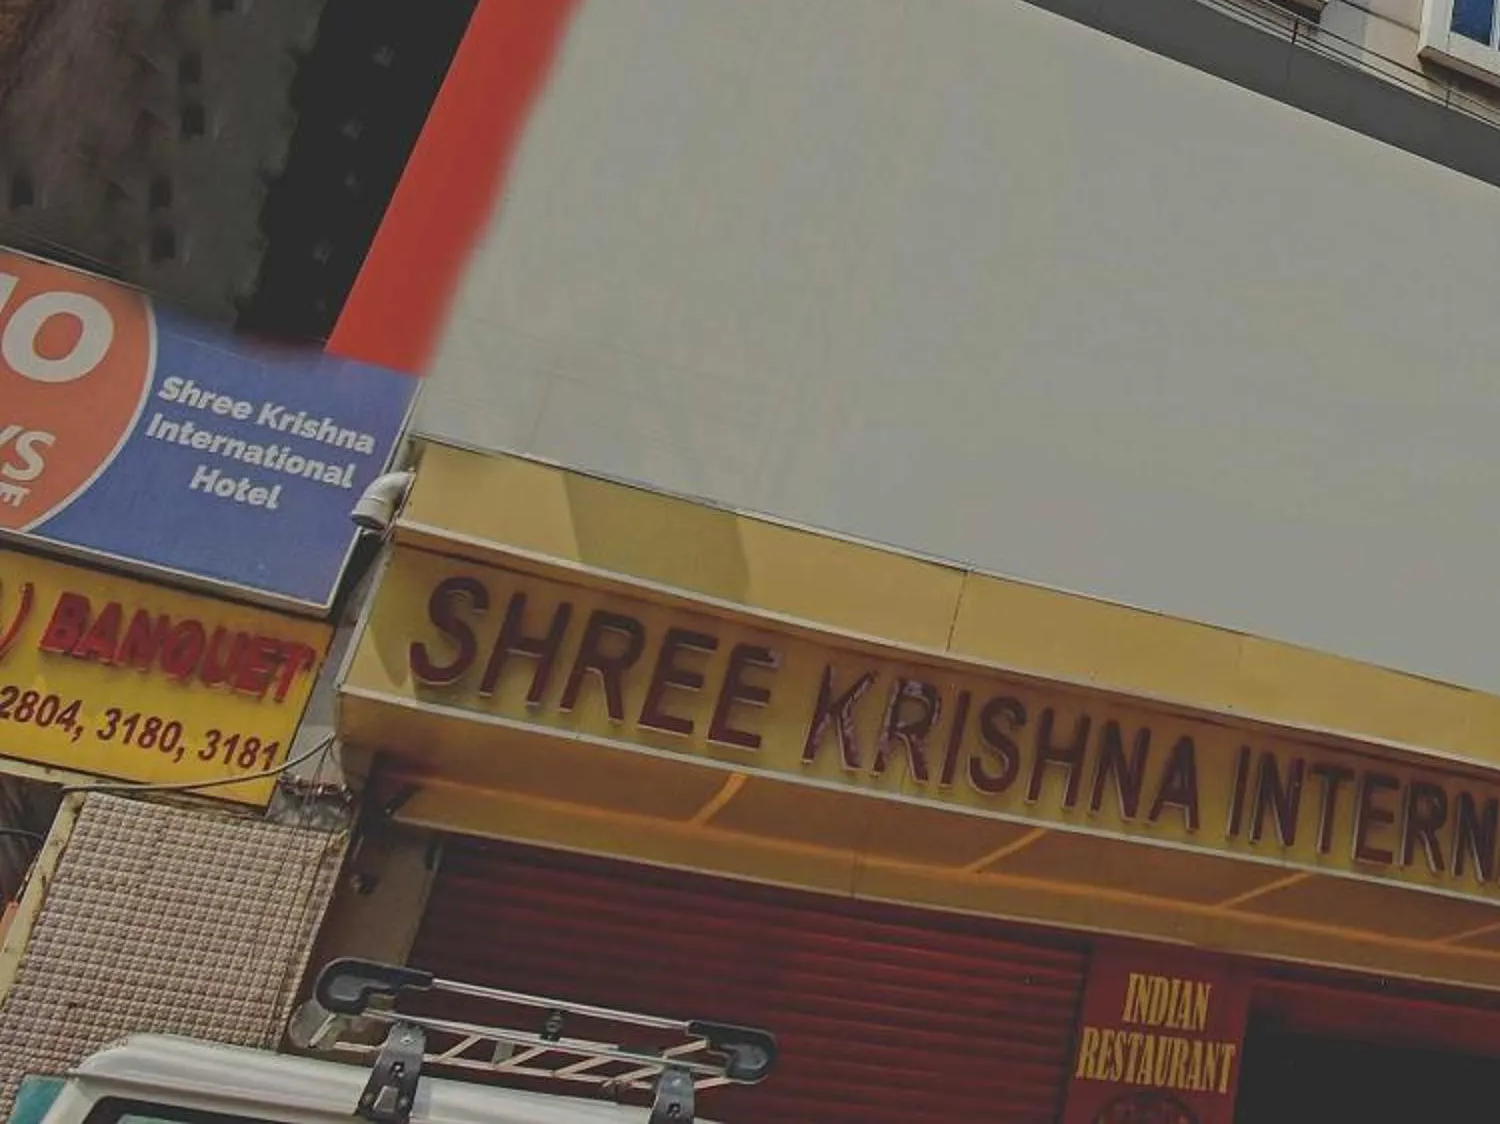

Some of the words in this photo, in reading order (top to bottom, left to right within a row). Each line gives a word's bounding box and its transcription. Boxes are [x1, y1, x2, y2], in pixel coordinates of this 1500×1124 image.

[146, 412, 356, 489] International
[158, 375, 253, 421] Shree
[254, 400, 376, 456] Krishna
[189, 464, 283, 510] Hotel
[39, 590, 316, 704] BANQUET
[96, 708, 186, 764] 3180,
[198, 728, 281, 771] 3181
[409, 575, 781, 751] SHREE
[802, 662, 1200, 834] KRISHNA
[1121, 972, 1212, 1031] INDIAN
[1074, 1026, 1237, 1095] RESTAURANT
